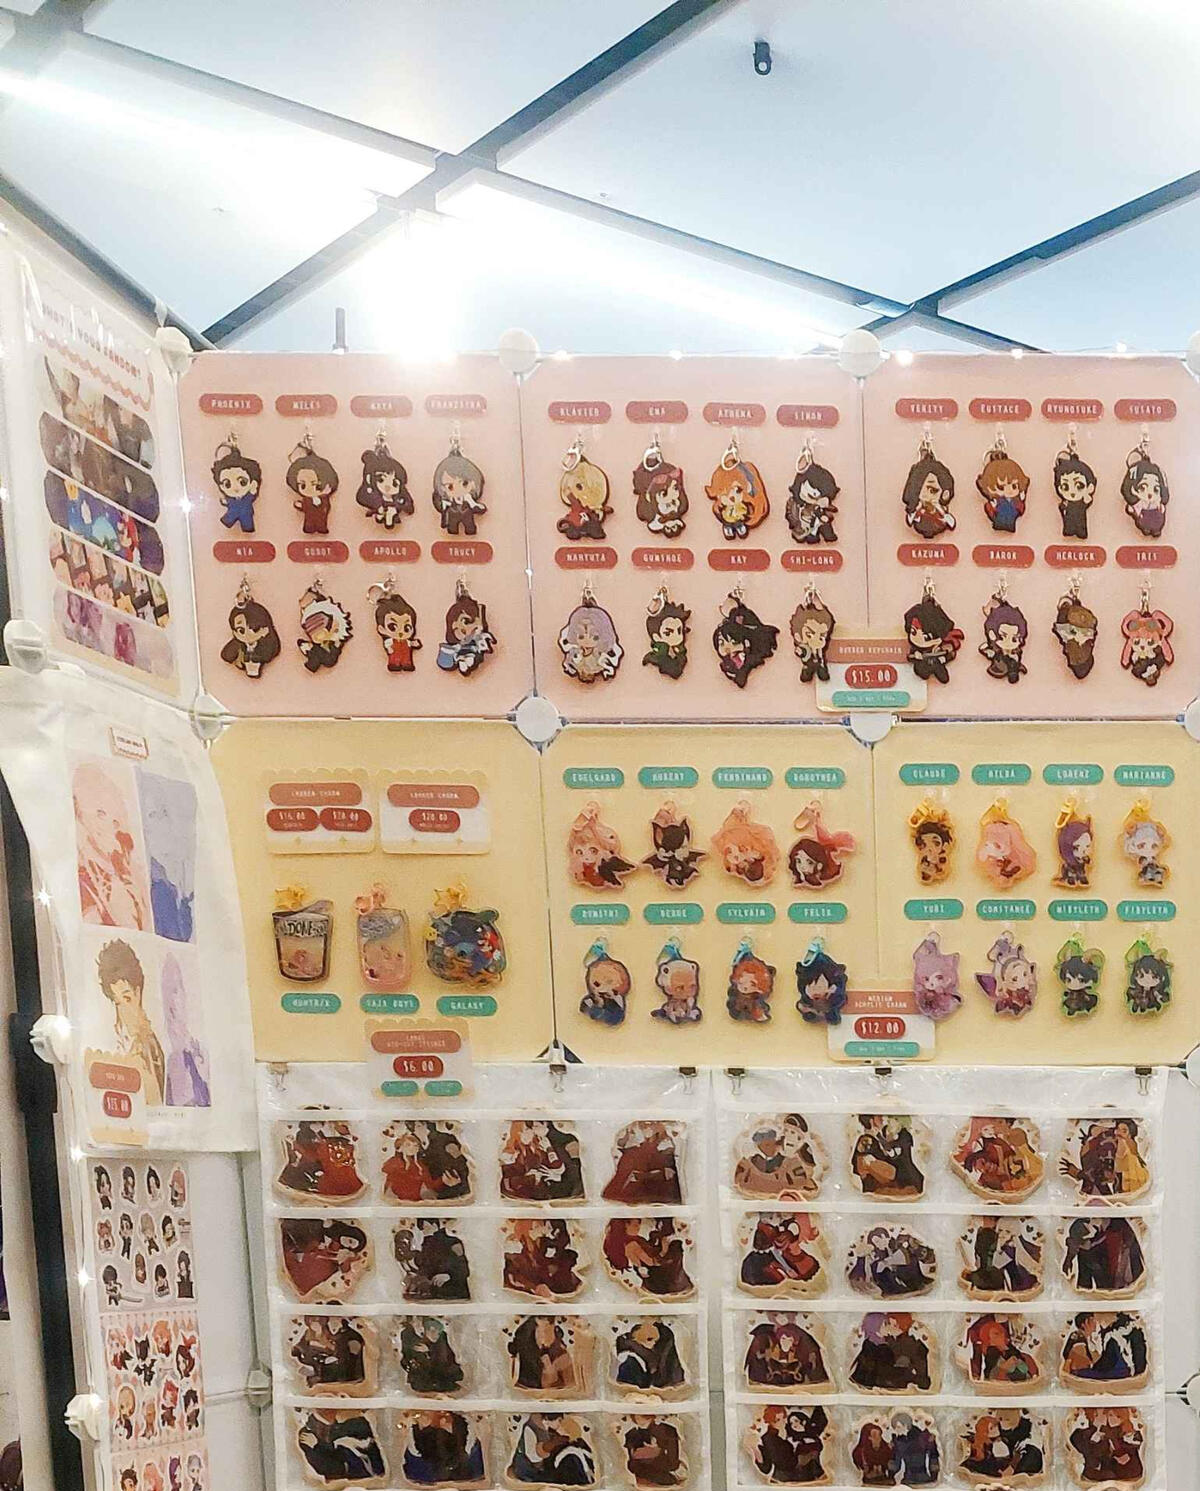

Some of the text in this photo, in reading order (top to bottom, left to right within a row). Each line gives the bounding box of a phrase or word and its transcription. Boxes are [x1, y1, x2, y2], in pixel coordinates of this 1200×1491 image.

[211, 399, 251, 409] PHOENIX
[292, 399, 321, 409] MILES
[430, 399, 482, 409] FRANZISKA
[910, 404, 945, 413] VERITY
[980, 404, 1019, 414] EUSTACE
[1046, 404, 1097, 414] RYUNOSUKE
[560, 407, 600, 417] KLAVIER
[648, 406, 666, 416] EMA
[717, 408, 753, 418] ATHENA
[1129, 404, 1162, 415] SUSATO
[793, 410, 824, 420] SIMON
[236, 547, 254, 556] MIA
[304, 546, 331, 556] GODOT
[373, 546, 407, 555] APOLLO
[449, 547, 476, 556] TRUCY
[911, 549, 945, 558] KAZUMA
[989, 550, 1018, 560] BAROK
[1056, 550, 1095, 560] HERLOCK
[566, 553, 606, 562] NAHYUTA
[643, 553, 682, 563] GUMSHOE
[731, 555, 748, 564] KAY
[789, 555, 834, 565] SHI-LONG
[1136, 551, 1158, 561] IRIS
[572, 773, 616, 782] EDELGARD
[652, 773, 685, 782] HUBERT
[717, 773, 768, 782] FERDINAND
[793, 773, 838, 782] DOROTHEA
[912, 769, 946, 778] CLAUDE
[988, 769, 1016, 778] HILDA
[1057, 769, 1090, 778] LORENZ
[1122, 770, 1166, 780] MARIANNE
[581, 909, 619, 918] DIMITRI
[660, 908, 688, 918] DEDUE
[727, 908, 766, 918] SYLVAIN
[803, 908, 832, 918] FELIX
[922, 904, 945, 914] YURI
[982, 904, 1031, 914] CONSTANCE
[450, 1000, 484, 1010] GALAXY
[861, 1022, 899, 1034] $12.00
[403, 1060, 434, 1072] $6.00
